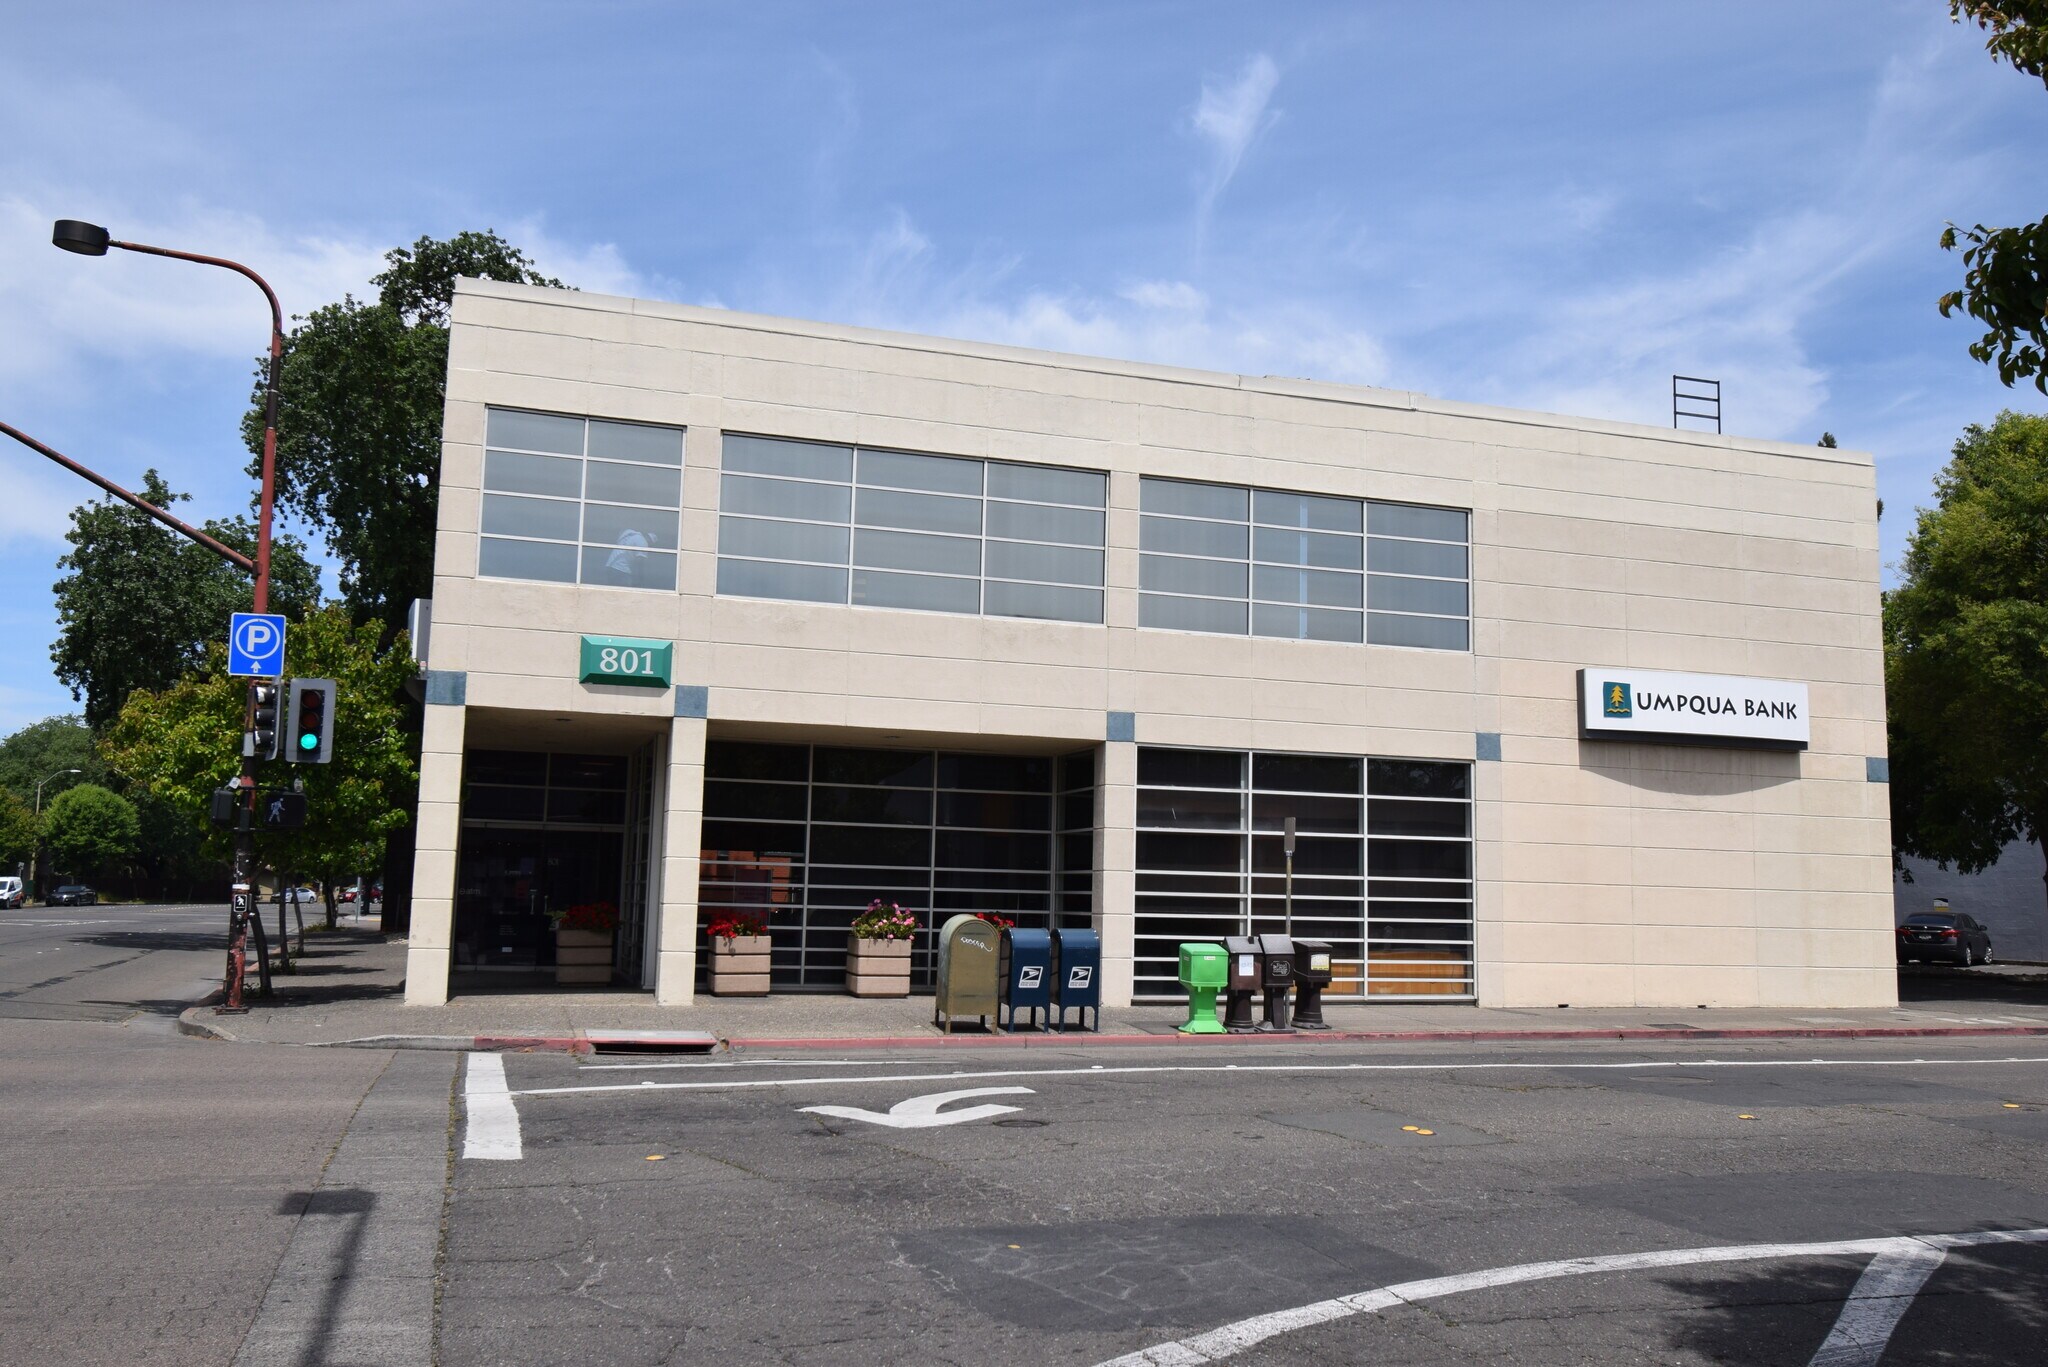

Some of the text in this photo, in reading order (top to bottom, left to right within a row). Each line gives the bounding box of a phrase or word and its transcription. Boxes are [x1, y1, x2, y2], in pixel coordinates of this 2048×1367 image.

[247, 625, 271, 652] P
[599, 647, 654, 675] 801
[1636, 692, 1798, 720] UMPQUA BANK
